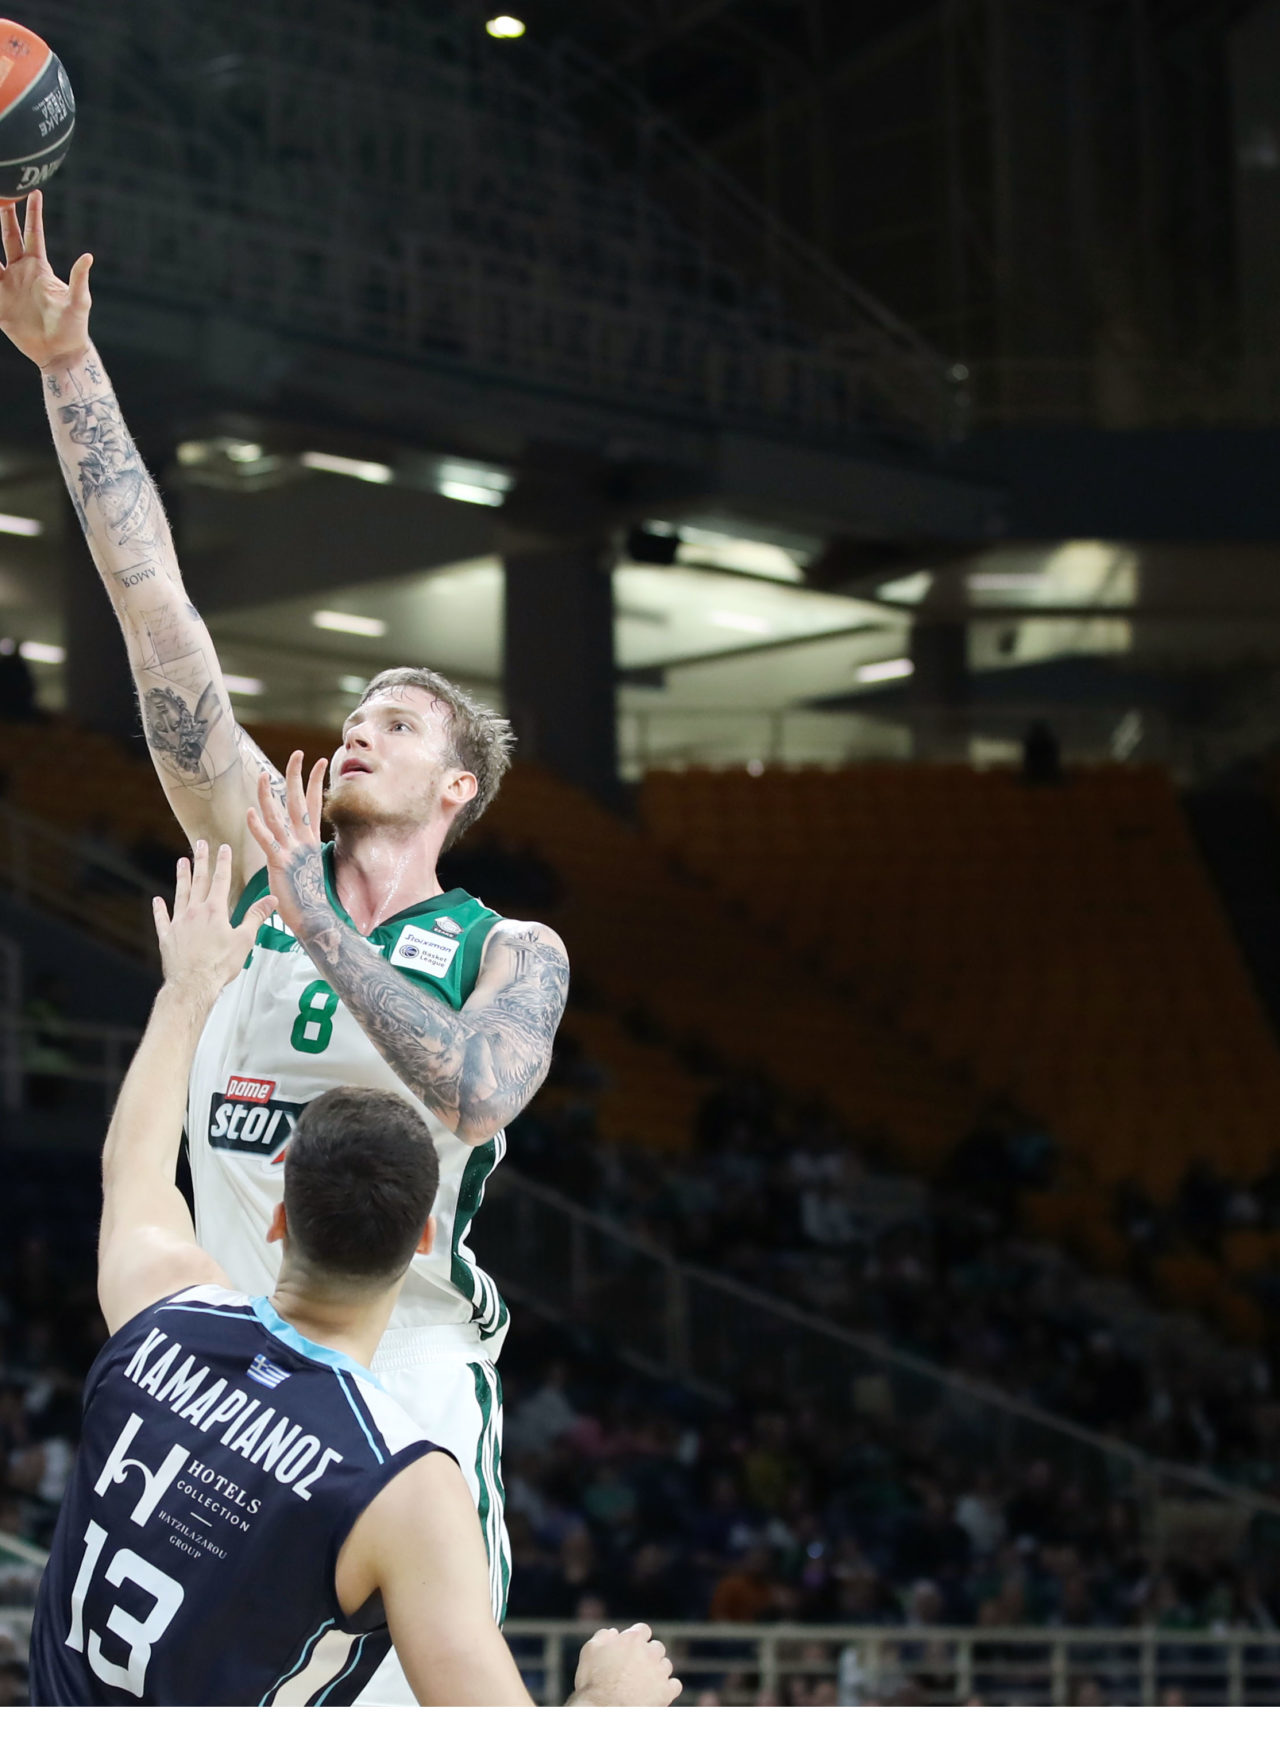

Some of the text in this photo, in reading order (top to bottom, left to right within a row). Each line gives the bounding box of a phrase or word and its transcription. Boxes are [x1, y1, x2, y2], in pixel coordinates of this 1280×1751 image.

[420, 955, 446, 968] League
[422, 950, 448, 963] Basket
[289, 979, 340, 1055] 8
[227, 1079, 271, 1099] pame
[176, 1480, 250, 1532] COLLECTION
[187, 1459, 262, 1514] HOTELS
[158, 1510, 228, 1560] HATZILAZAROU
[169, 1535, 201, 1559] GROUP
[65, 1519, 185, 1698] 13
